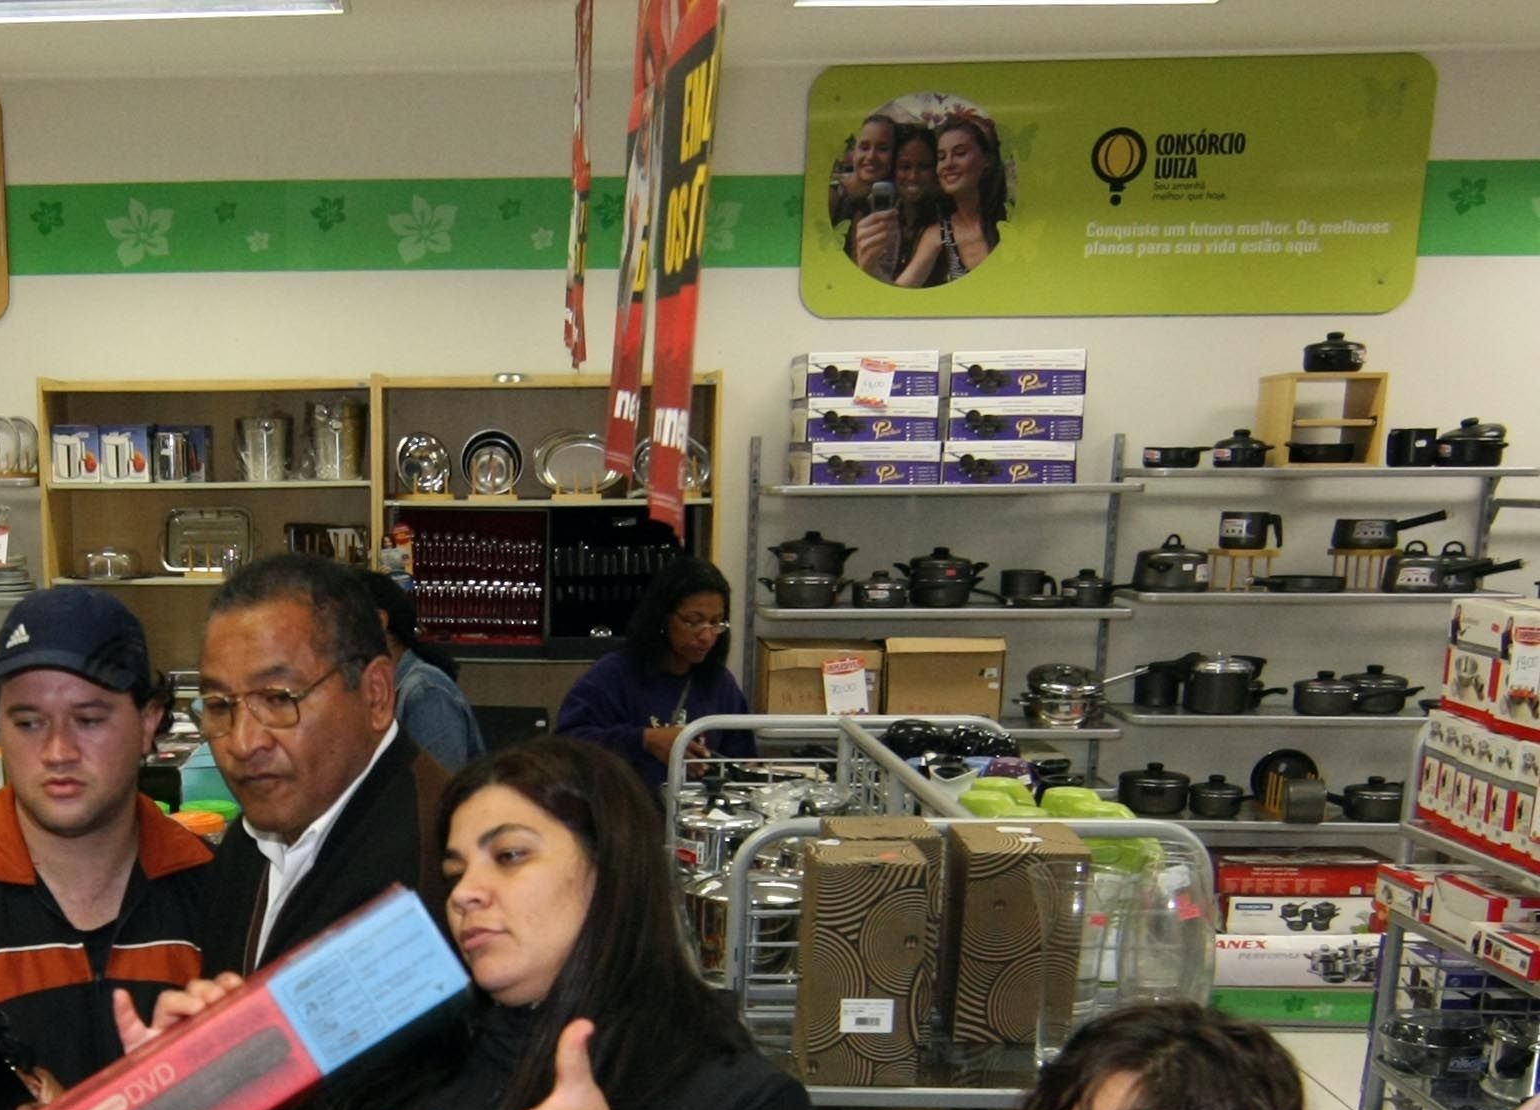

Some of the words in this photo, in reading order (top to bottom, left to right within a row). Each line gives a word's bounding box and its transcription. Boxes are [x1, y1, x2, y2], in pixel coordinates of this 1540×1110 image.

[1155, 129, 1246, 155] CONSÓRCIO
[1154, 157, 1197, 179] LUIZA
[1086, 222, 1159, 240] Conquiste
[1164, 224, 1185, 236] um
[1190, 221, 1233, 236] futuro
[1296, 219, 1315, 235] Os
[1319, 219, 1390, 235] melhores
[1084, 241, 1133, 258] planos
[1137, 242, 1171, 258] para
[1175, 243, 1200, 255] sua
[1205, 239, 1236, 254] vida
[1241, 239, 1282, 253] estão
[123, 1062, 176, 1105] DVD
